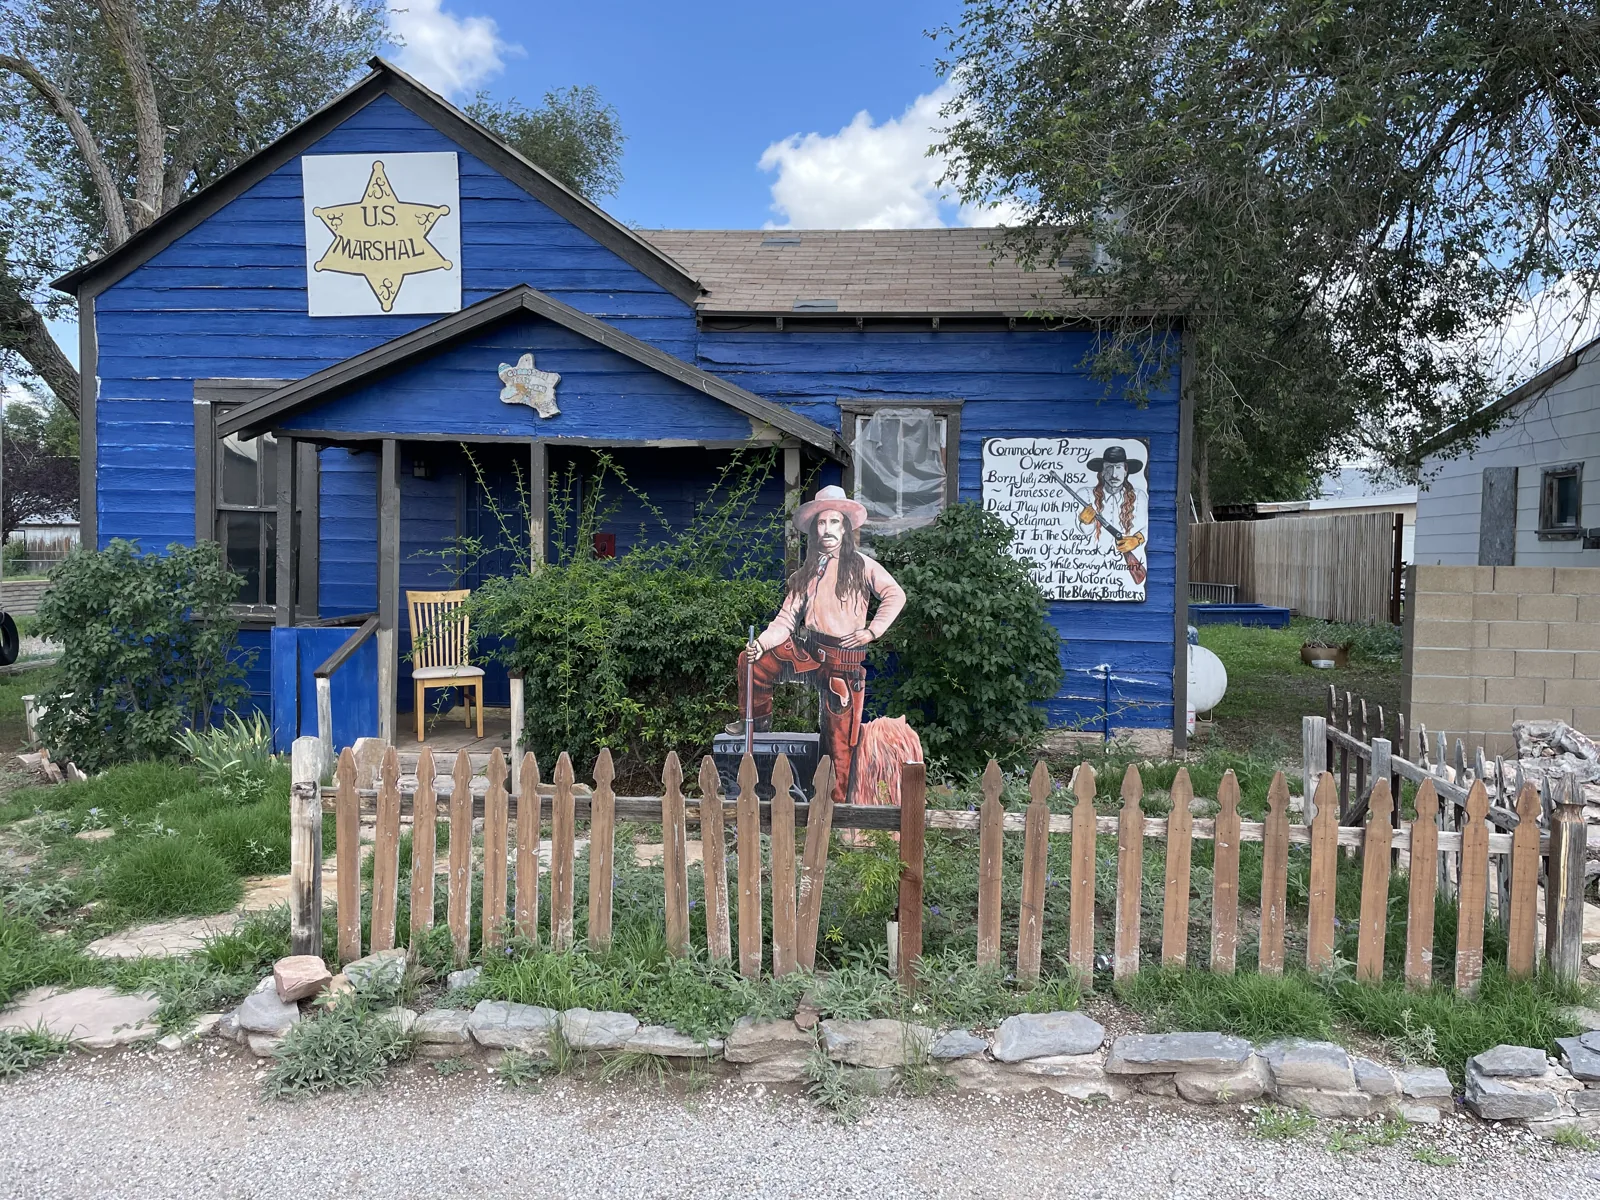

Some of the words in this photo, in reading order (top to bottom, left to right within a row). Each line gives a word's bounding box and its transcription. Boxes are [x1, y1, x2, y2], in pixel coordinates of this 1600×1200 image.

[361, 205, 399, 227] U.S.
[332, 234, 425, 261] MARSHAL
[988, 439, 1053, 457] Commodore
[1057, 439, 1094, 463] Perry
[1019, 456, 1064, 470] Owens
[984, 470, 1017, 484] Born
[1018, 471, 1037, 488] July
[1063, 473, 1088, 484] 1852
[1006, 482, 1065, 498] Tennessee
[987, 499, 1012, 512] Died
[1016, 502, 1038, 517] May
[1040, 502, 1060, 512] 10th
[1061, 502, 1080, 513] 1919
[1007, 511, 1061, 528] Seligman
[1030, 529, 1043, 541] In
[1043, 529, 1060, 541] The
[1060, 528, 1093, 546] Sleepy
[1013, 542, 1037, 555] Town
[1040, 543, 1054, 560] Of
[1053, 543, 1106, 558] Holbrook,
[1050, 556, 1072, 570] While
[1072, 557, 1101, 575] Serving
[1099, 560, 1108, 570] A
[1108, 558, 1144, 572] Warrant
[1055, 570, 1072, 584] The
[1072, 570, 1124, 587] Notorius
[1055, 585, 1072, 599] The
[1072, 585, 1101, 600] Blevins
[1100, 585, 1144, 600] Brothers
